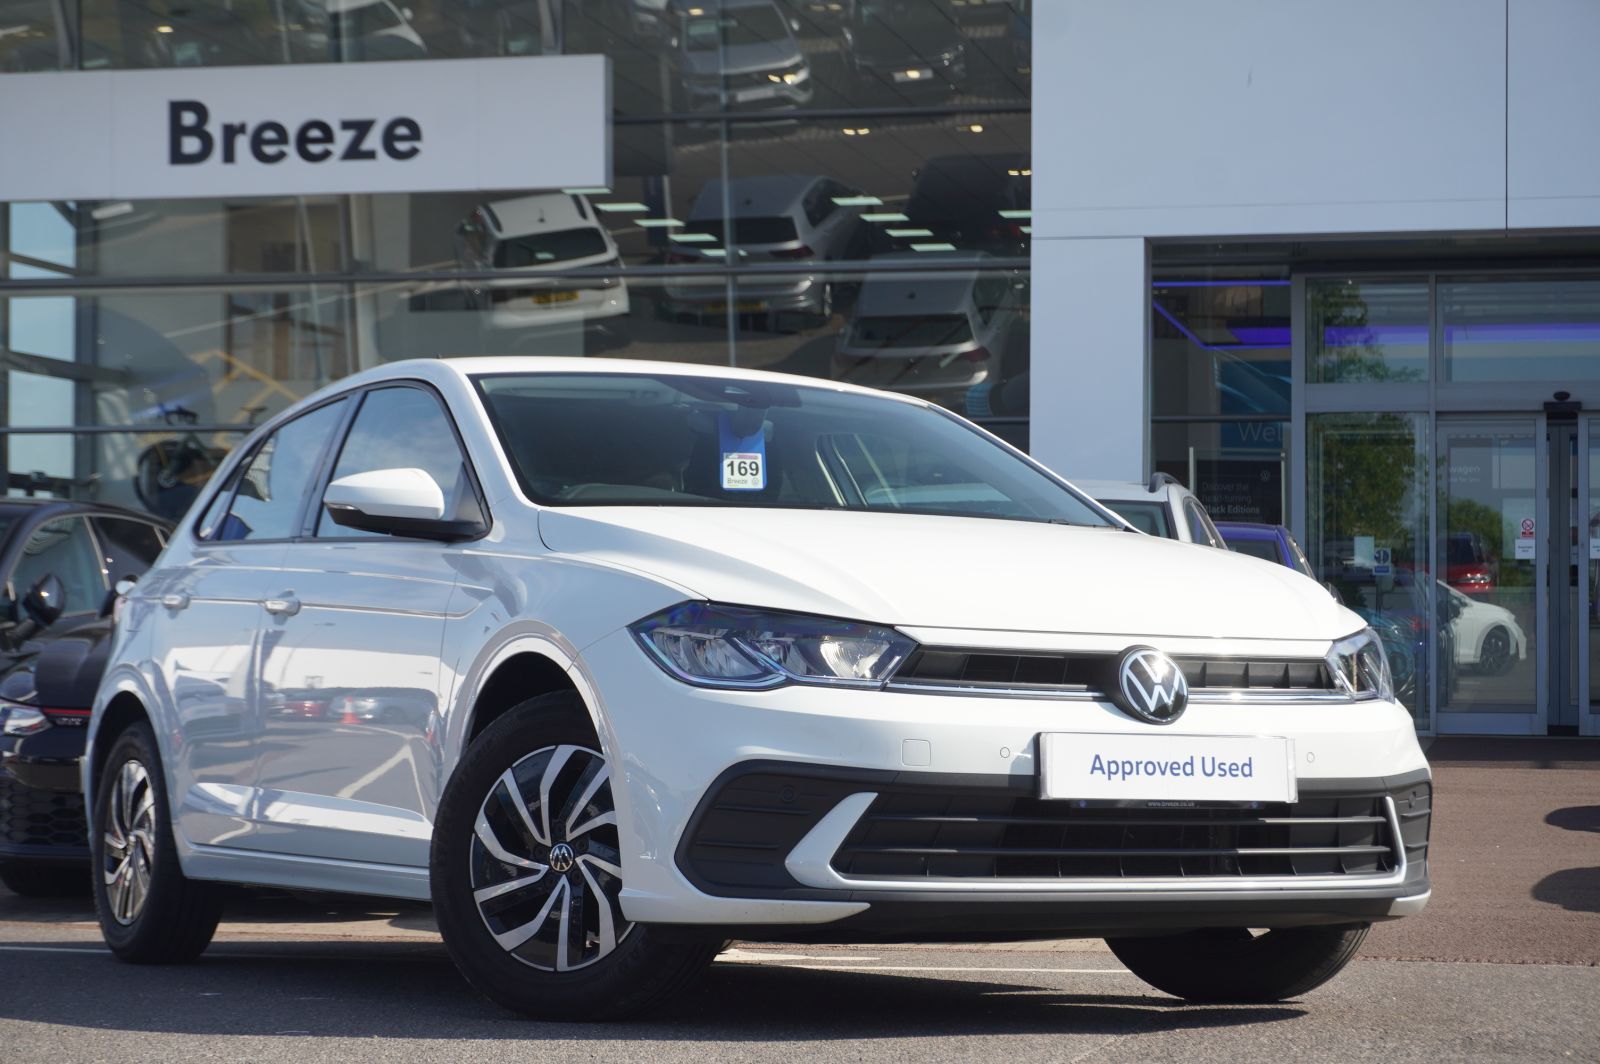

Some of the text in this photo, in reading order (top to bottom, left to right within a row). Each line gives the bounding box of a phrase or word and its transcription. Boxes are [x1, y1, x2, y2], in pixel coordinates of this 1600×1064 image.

[168, 99, 423, 166] Breeze
[727, 460, 760, 477] 169
[1227, 504, 1260, 514] Editions
[1090, 753, 1253, 780] Approved Used
